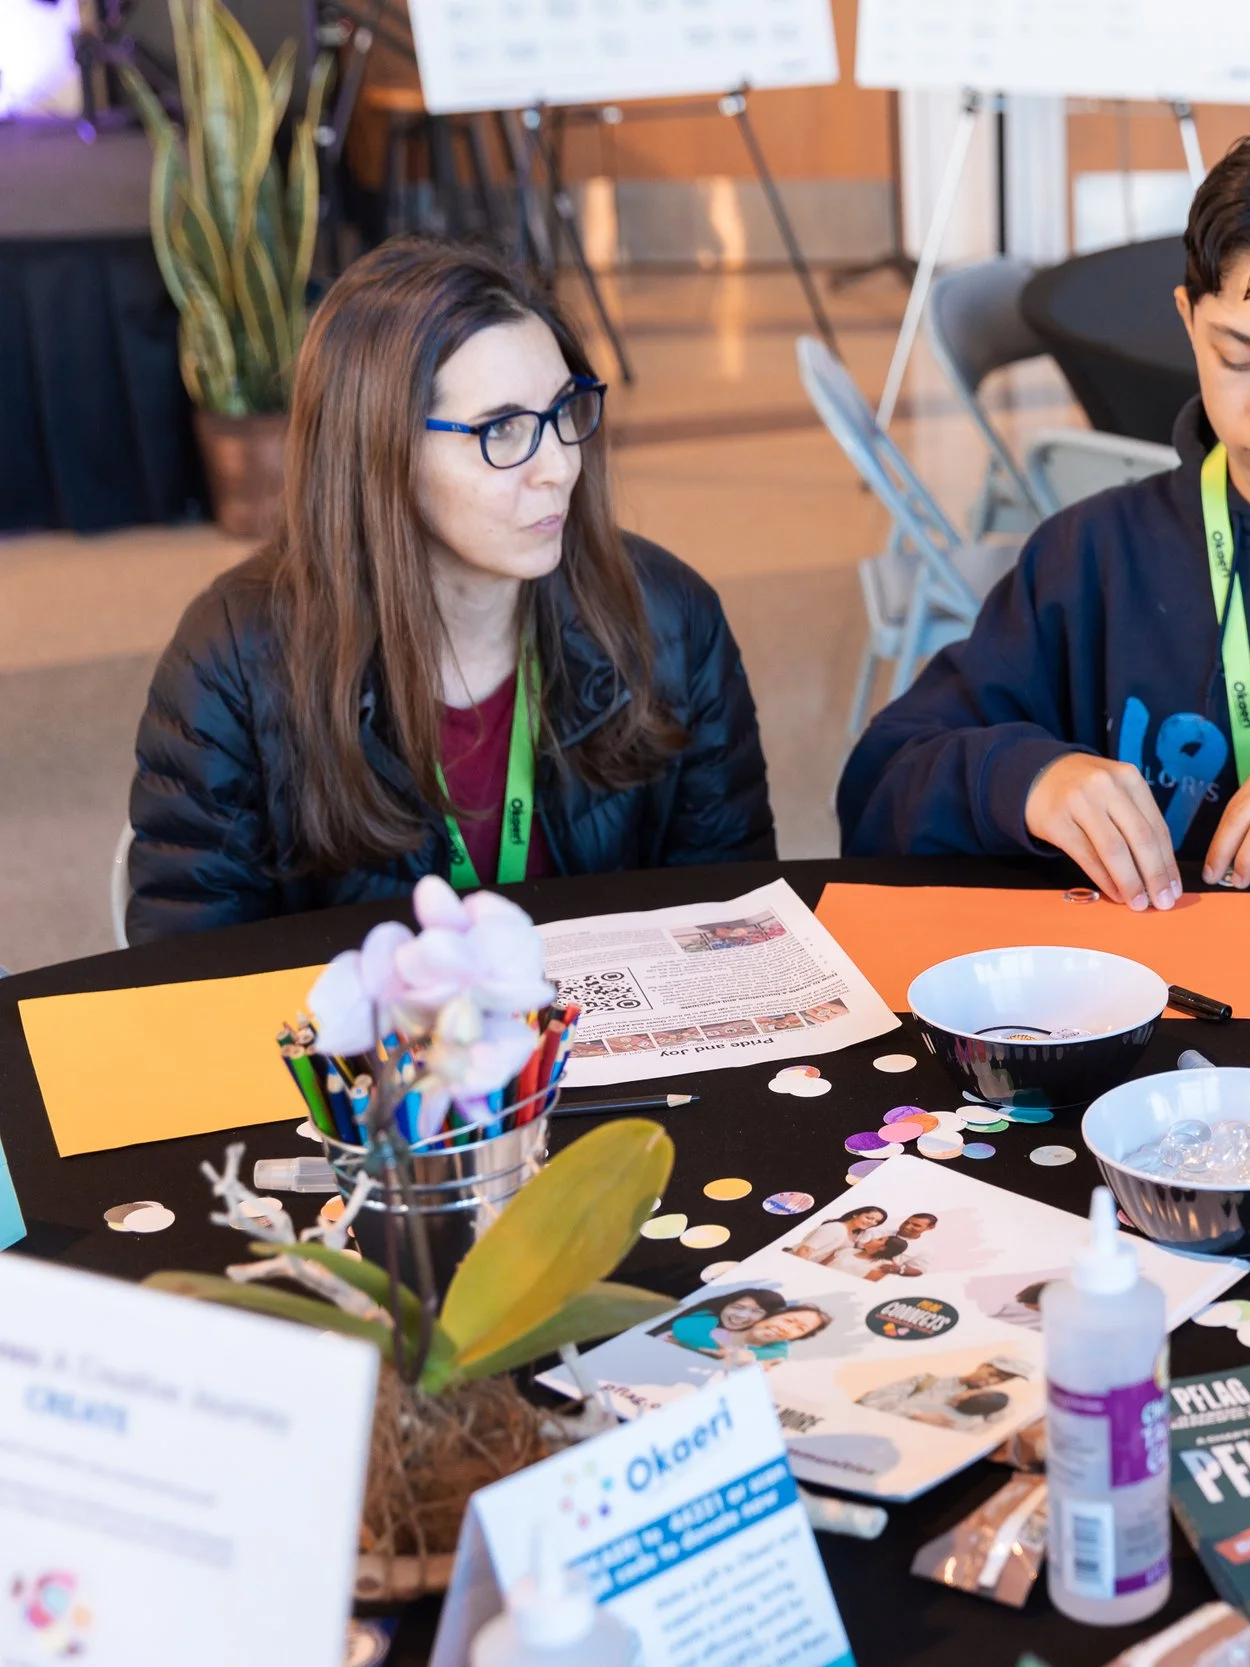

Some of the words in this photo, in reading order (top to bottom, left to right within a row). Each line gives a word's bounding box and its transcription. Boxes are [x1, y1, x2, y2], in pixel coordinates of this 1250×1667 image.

[1212, 530, 1231, 578] Okaeri
[510, 797, 527, 846] Okaeri
[658, 1048, 689, 1058] Joy
[693, 1044, 725, 1052] and
[729, 1037, 775, 1048] Pride
[626, 1396, 734, 1493] Okaeri
